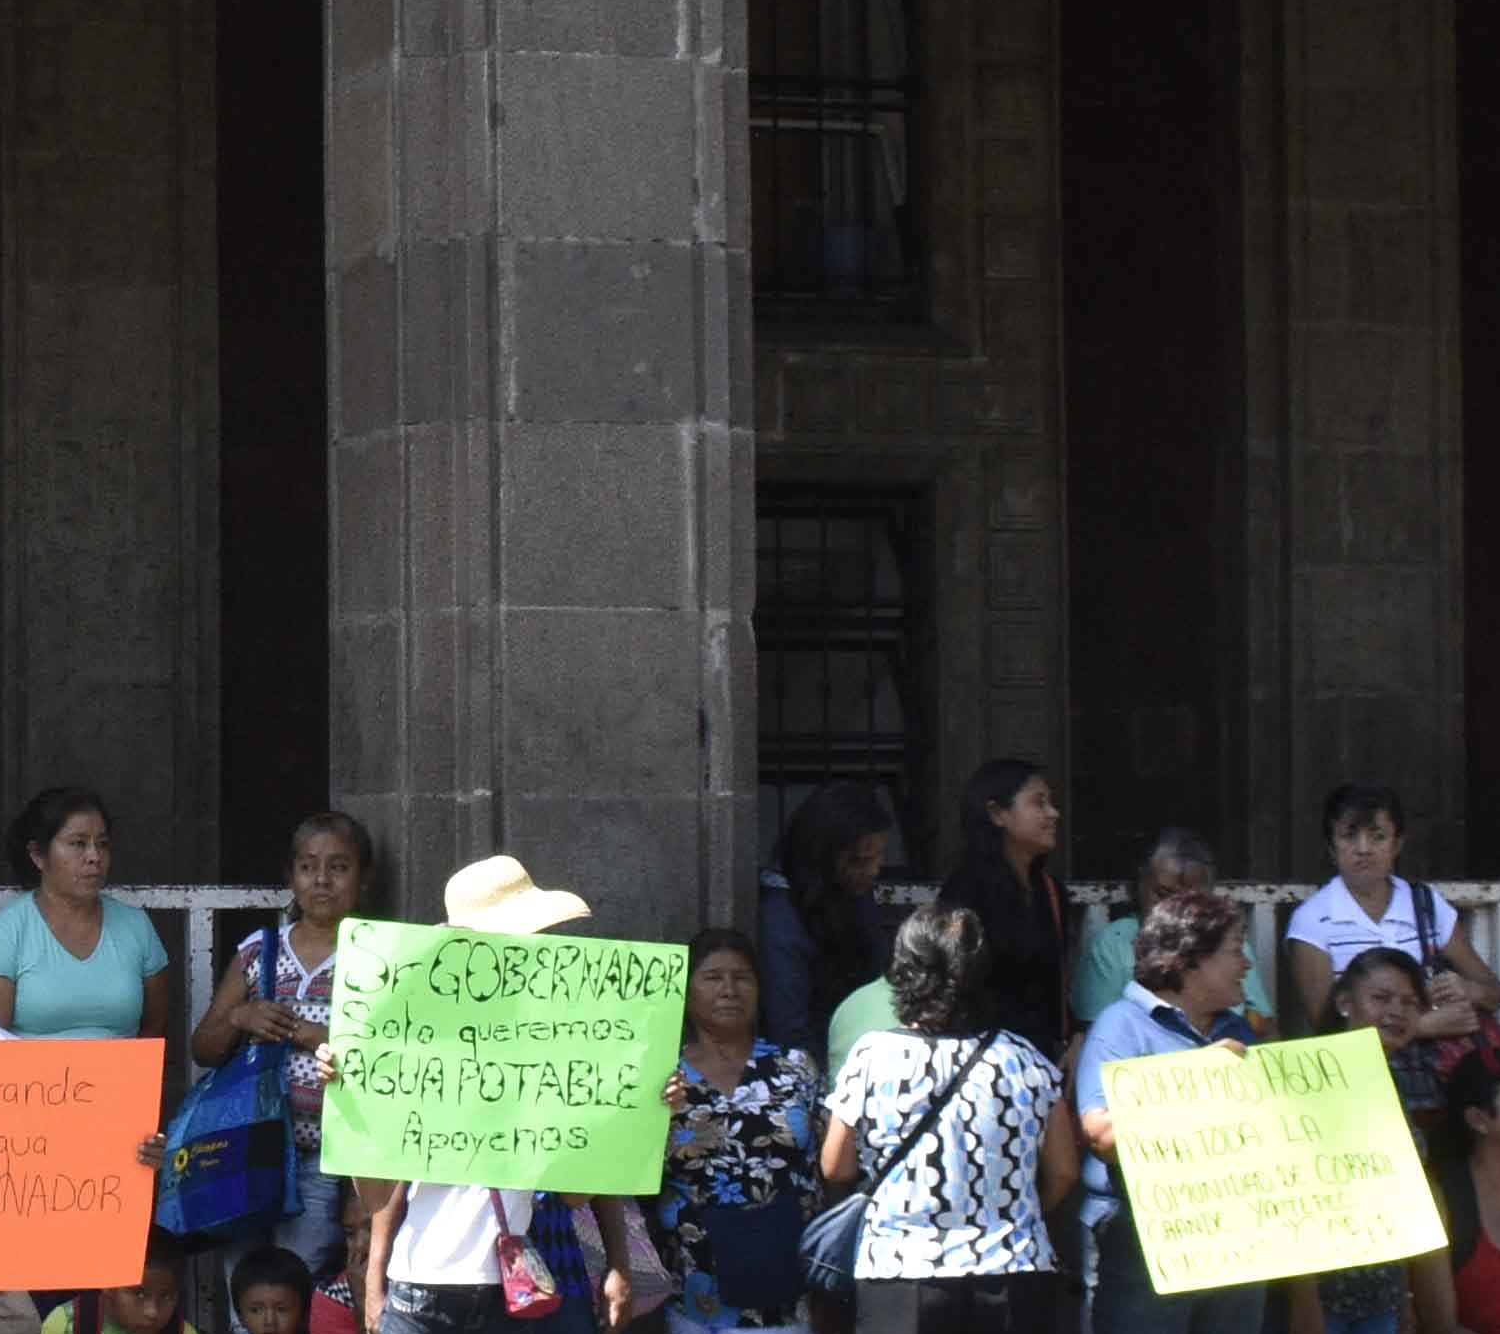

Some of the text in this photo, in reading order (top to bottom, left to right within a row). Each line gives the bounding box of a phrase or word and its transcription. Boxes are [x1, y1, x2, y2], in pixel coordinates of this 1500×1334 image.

[344, 922, 685, 1004] Sr GOBERNADOR
[335, 999, 636, 1061] Solo queremos
[338, 1047, 641, 1110] AGUA POTABLE
[1257, 1047, 1350, 1098] AGUA
[400, 1110, 590, 1172] Apoyenos
[1279, 1114, 1323, 1144] LA
